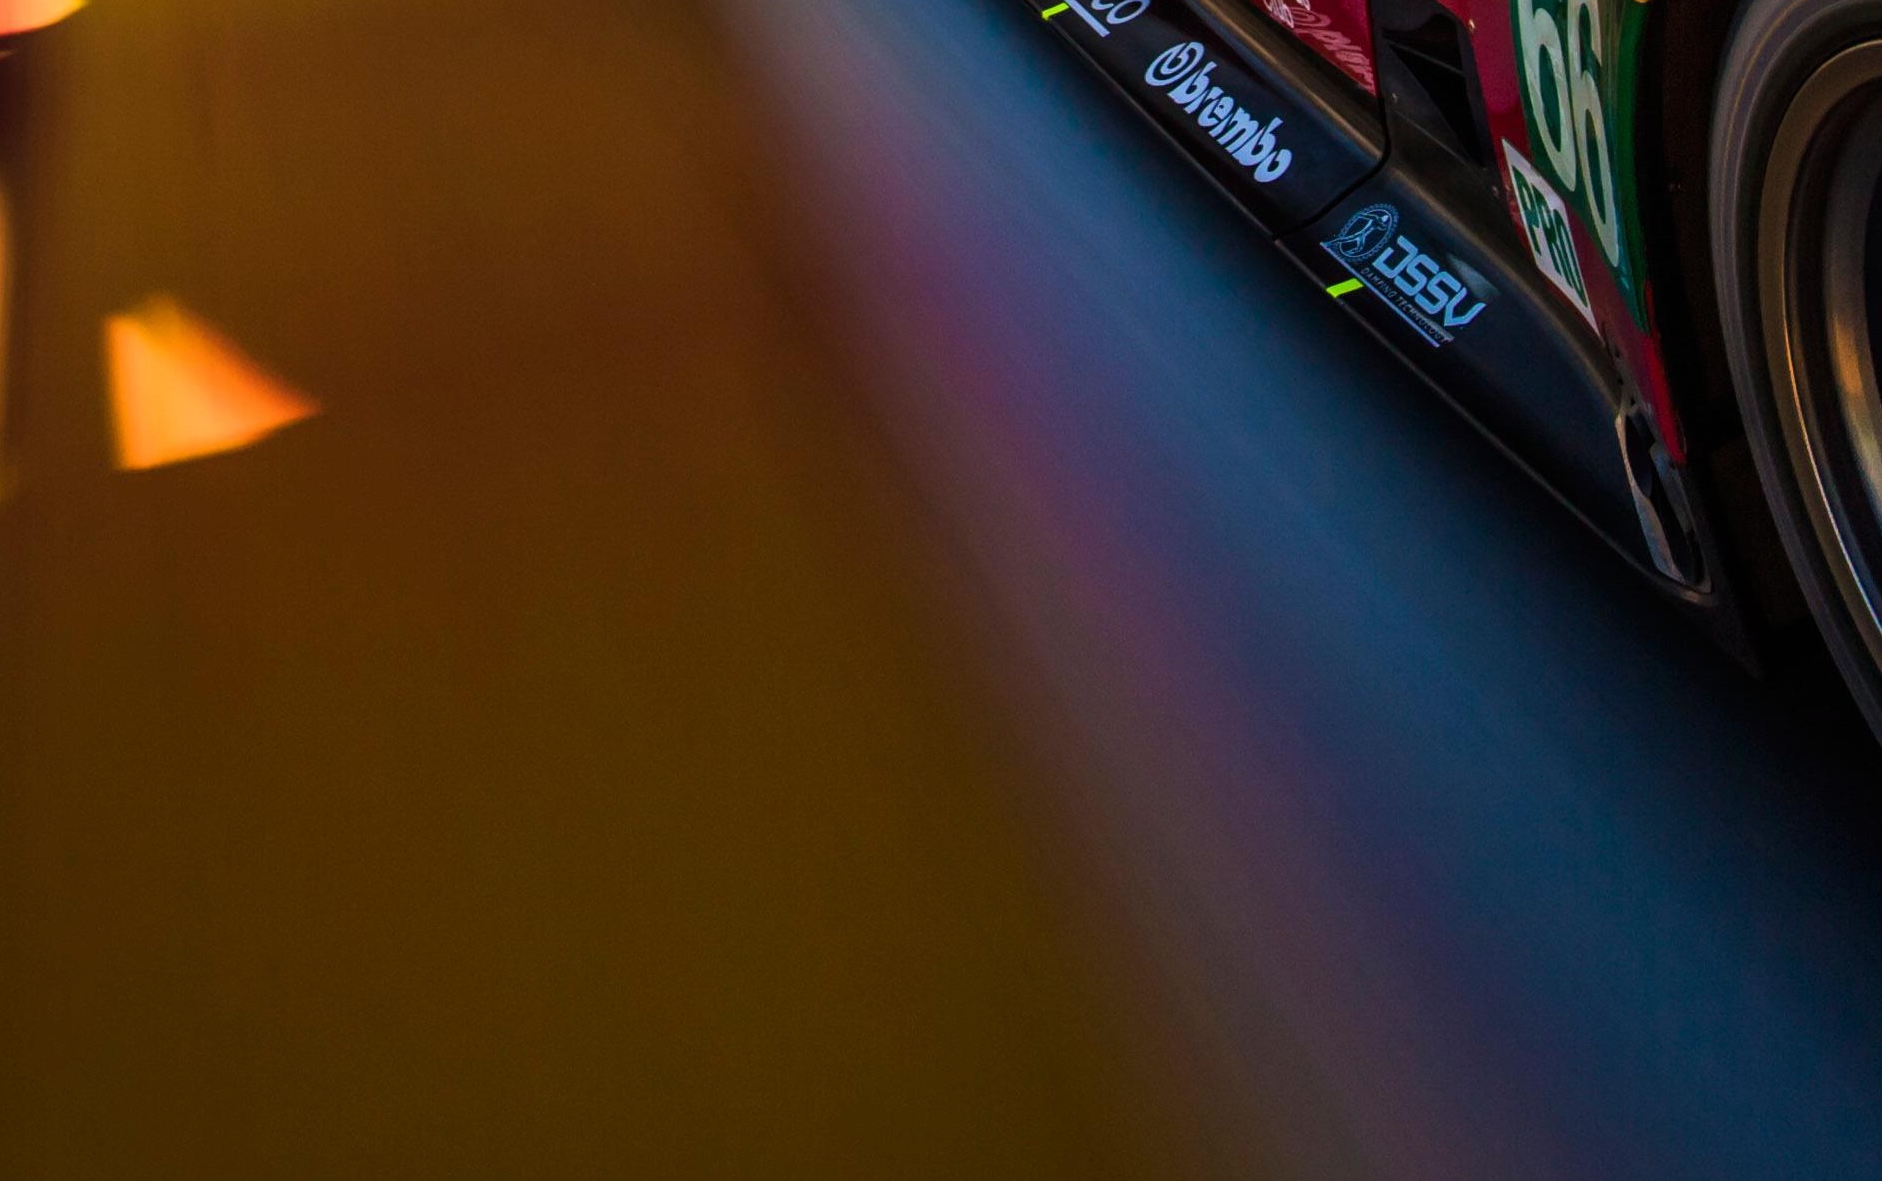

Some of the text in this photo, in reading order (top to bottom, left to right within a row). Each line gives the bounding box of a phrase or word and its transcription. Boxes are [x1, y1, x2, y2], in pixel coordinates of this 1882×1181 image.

[1166, 60, 1293, 184] brembo
[1372, 234, 1487, 327] DSSV
[1511, 163, 1589, 309] PRO
[1359, 267, 1450, 344] DAMPING TECHNOLOGY
